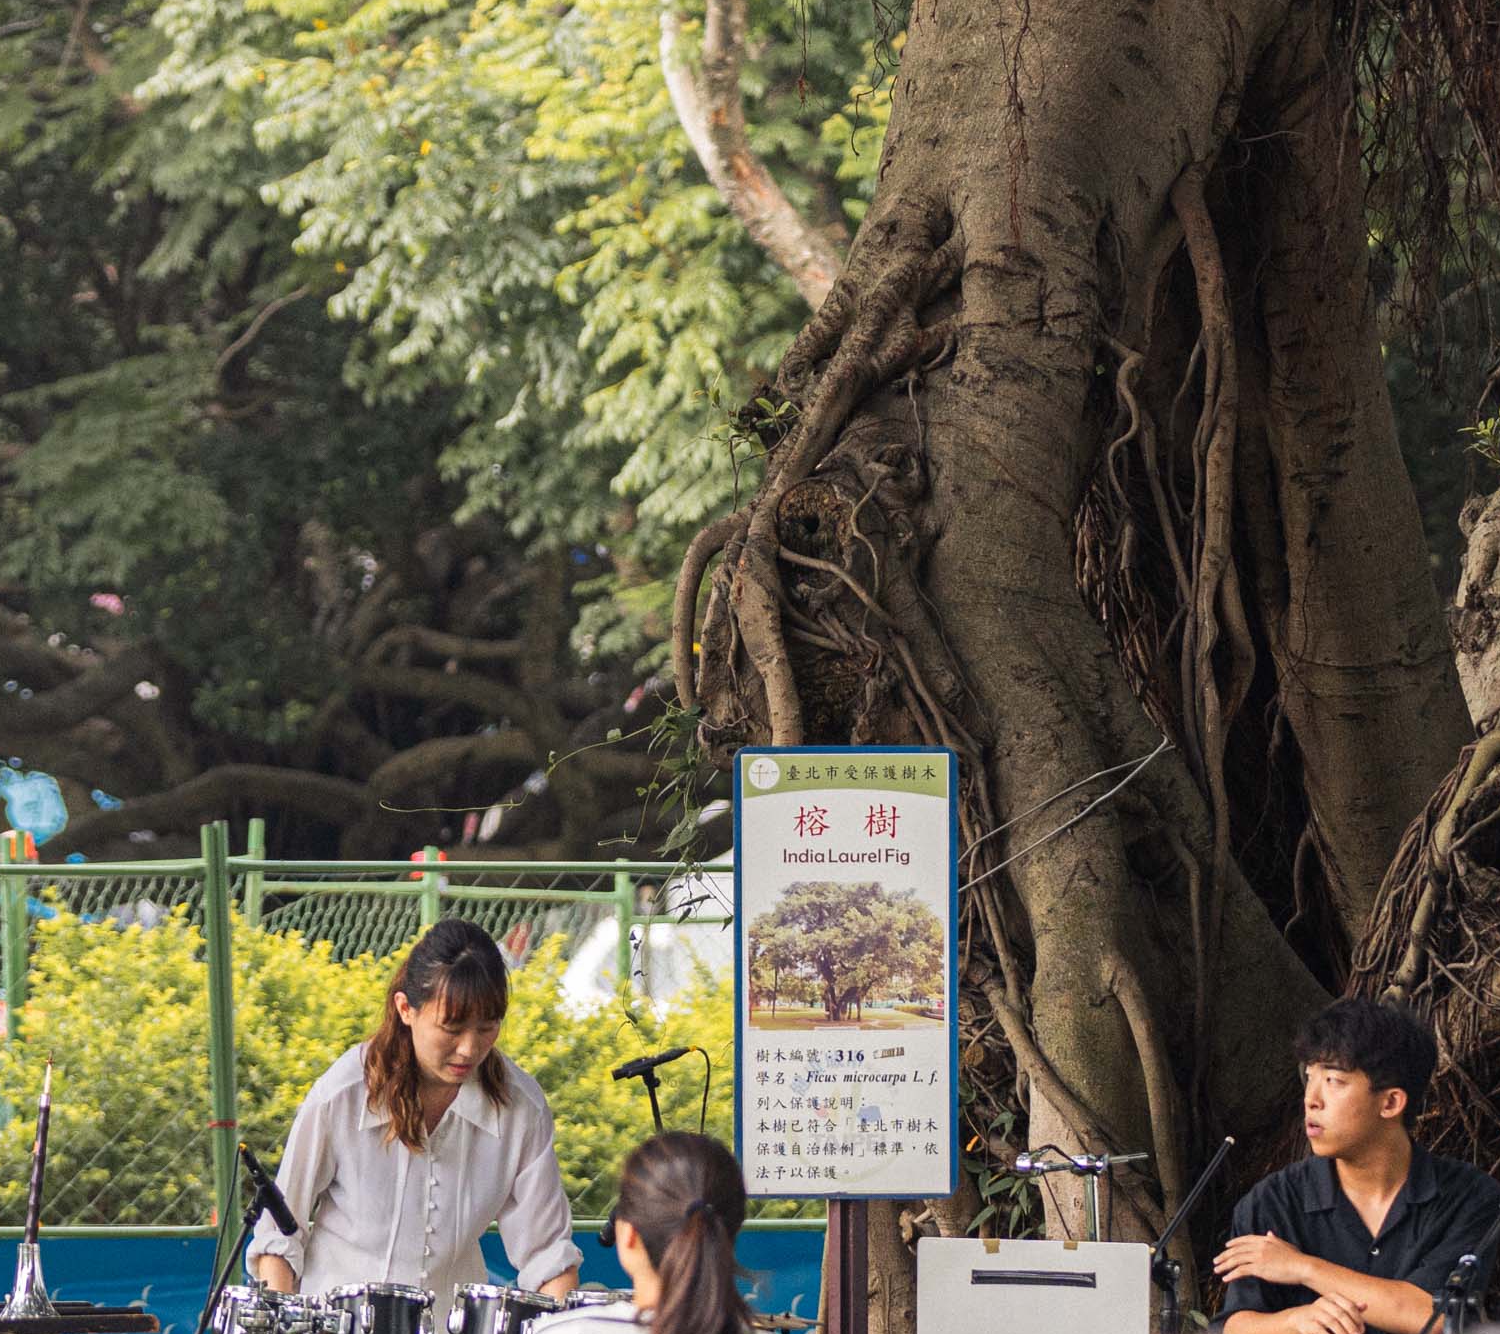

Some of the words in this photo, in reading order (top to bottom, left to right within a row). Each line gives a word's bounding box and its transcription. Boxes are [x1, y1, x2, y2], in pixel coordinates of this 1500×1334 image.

[786, 764, 937, 781] 臺北市受保護樹木
[783, 848, 825, 864] India
[828, 848, 882, 864] Laurel
[885, 848, 910, 866] Fig
[806, 1070, 837, 1083] Ficus
[843, 1070, 907, 1086] microcarpa
[913, 1070, 924, 1083] L.
